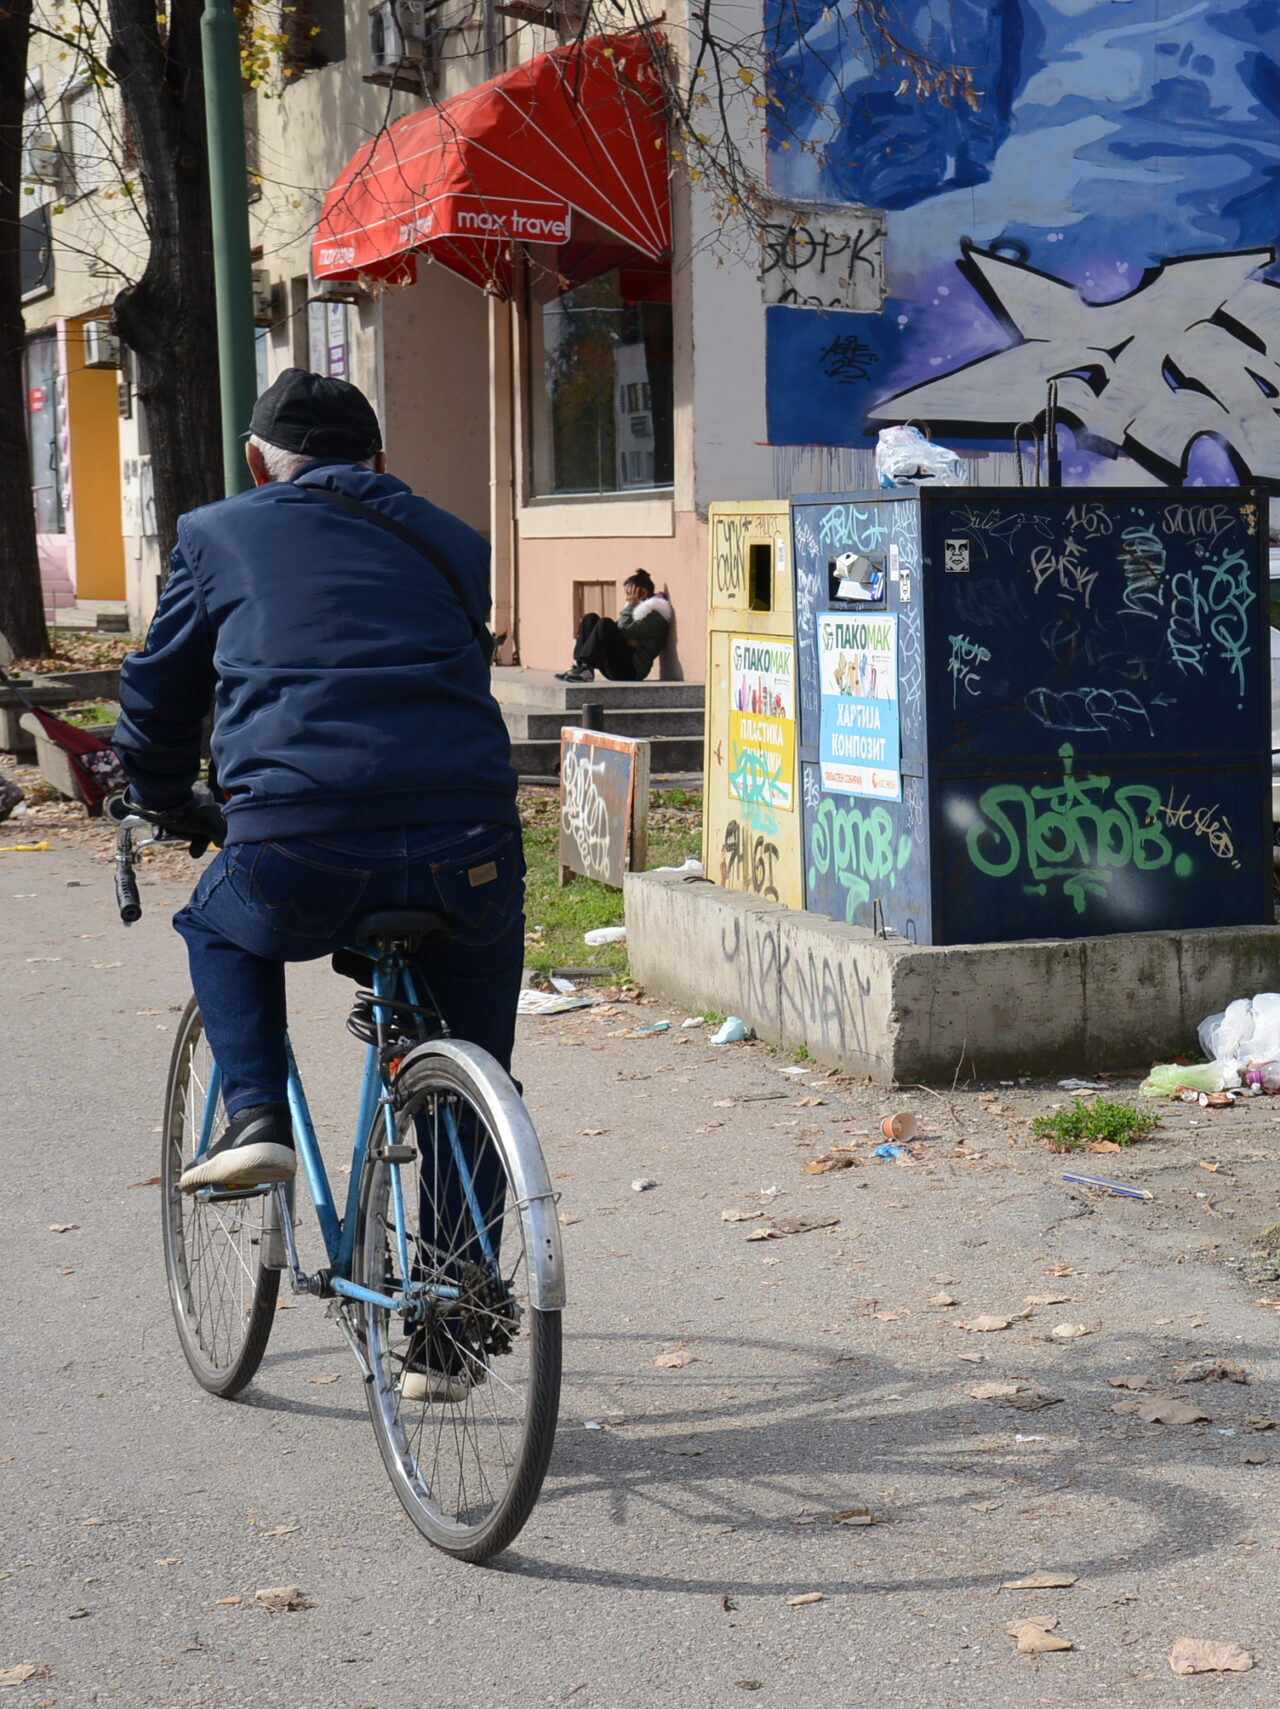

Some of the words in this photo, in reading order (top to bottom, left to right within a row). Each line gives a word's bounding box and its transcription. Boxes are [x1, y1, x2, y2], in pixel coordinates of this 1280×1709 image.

[457, 209, 507, 231] max
[511, 209, 570, 237] travel
[835, 623, 892, 651] ПАКОМАК
[743, 646, 791, 676] ПАКОМАК
[836, 703, 881, 730] ХАРТИЈА
[740, 718, 784, 747] ПЛАСТИКА
[831, 733, 886, 762] КОМПОЗИТ
